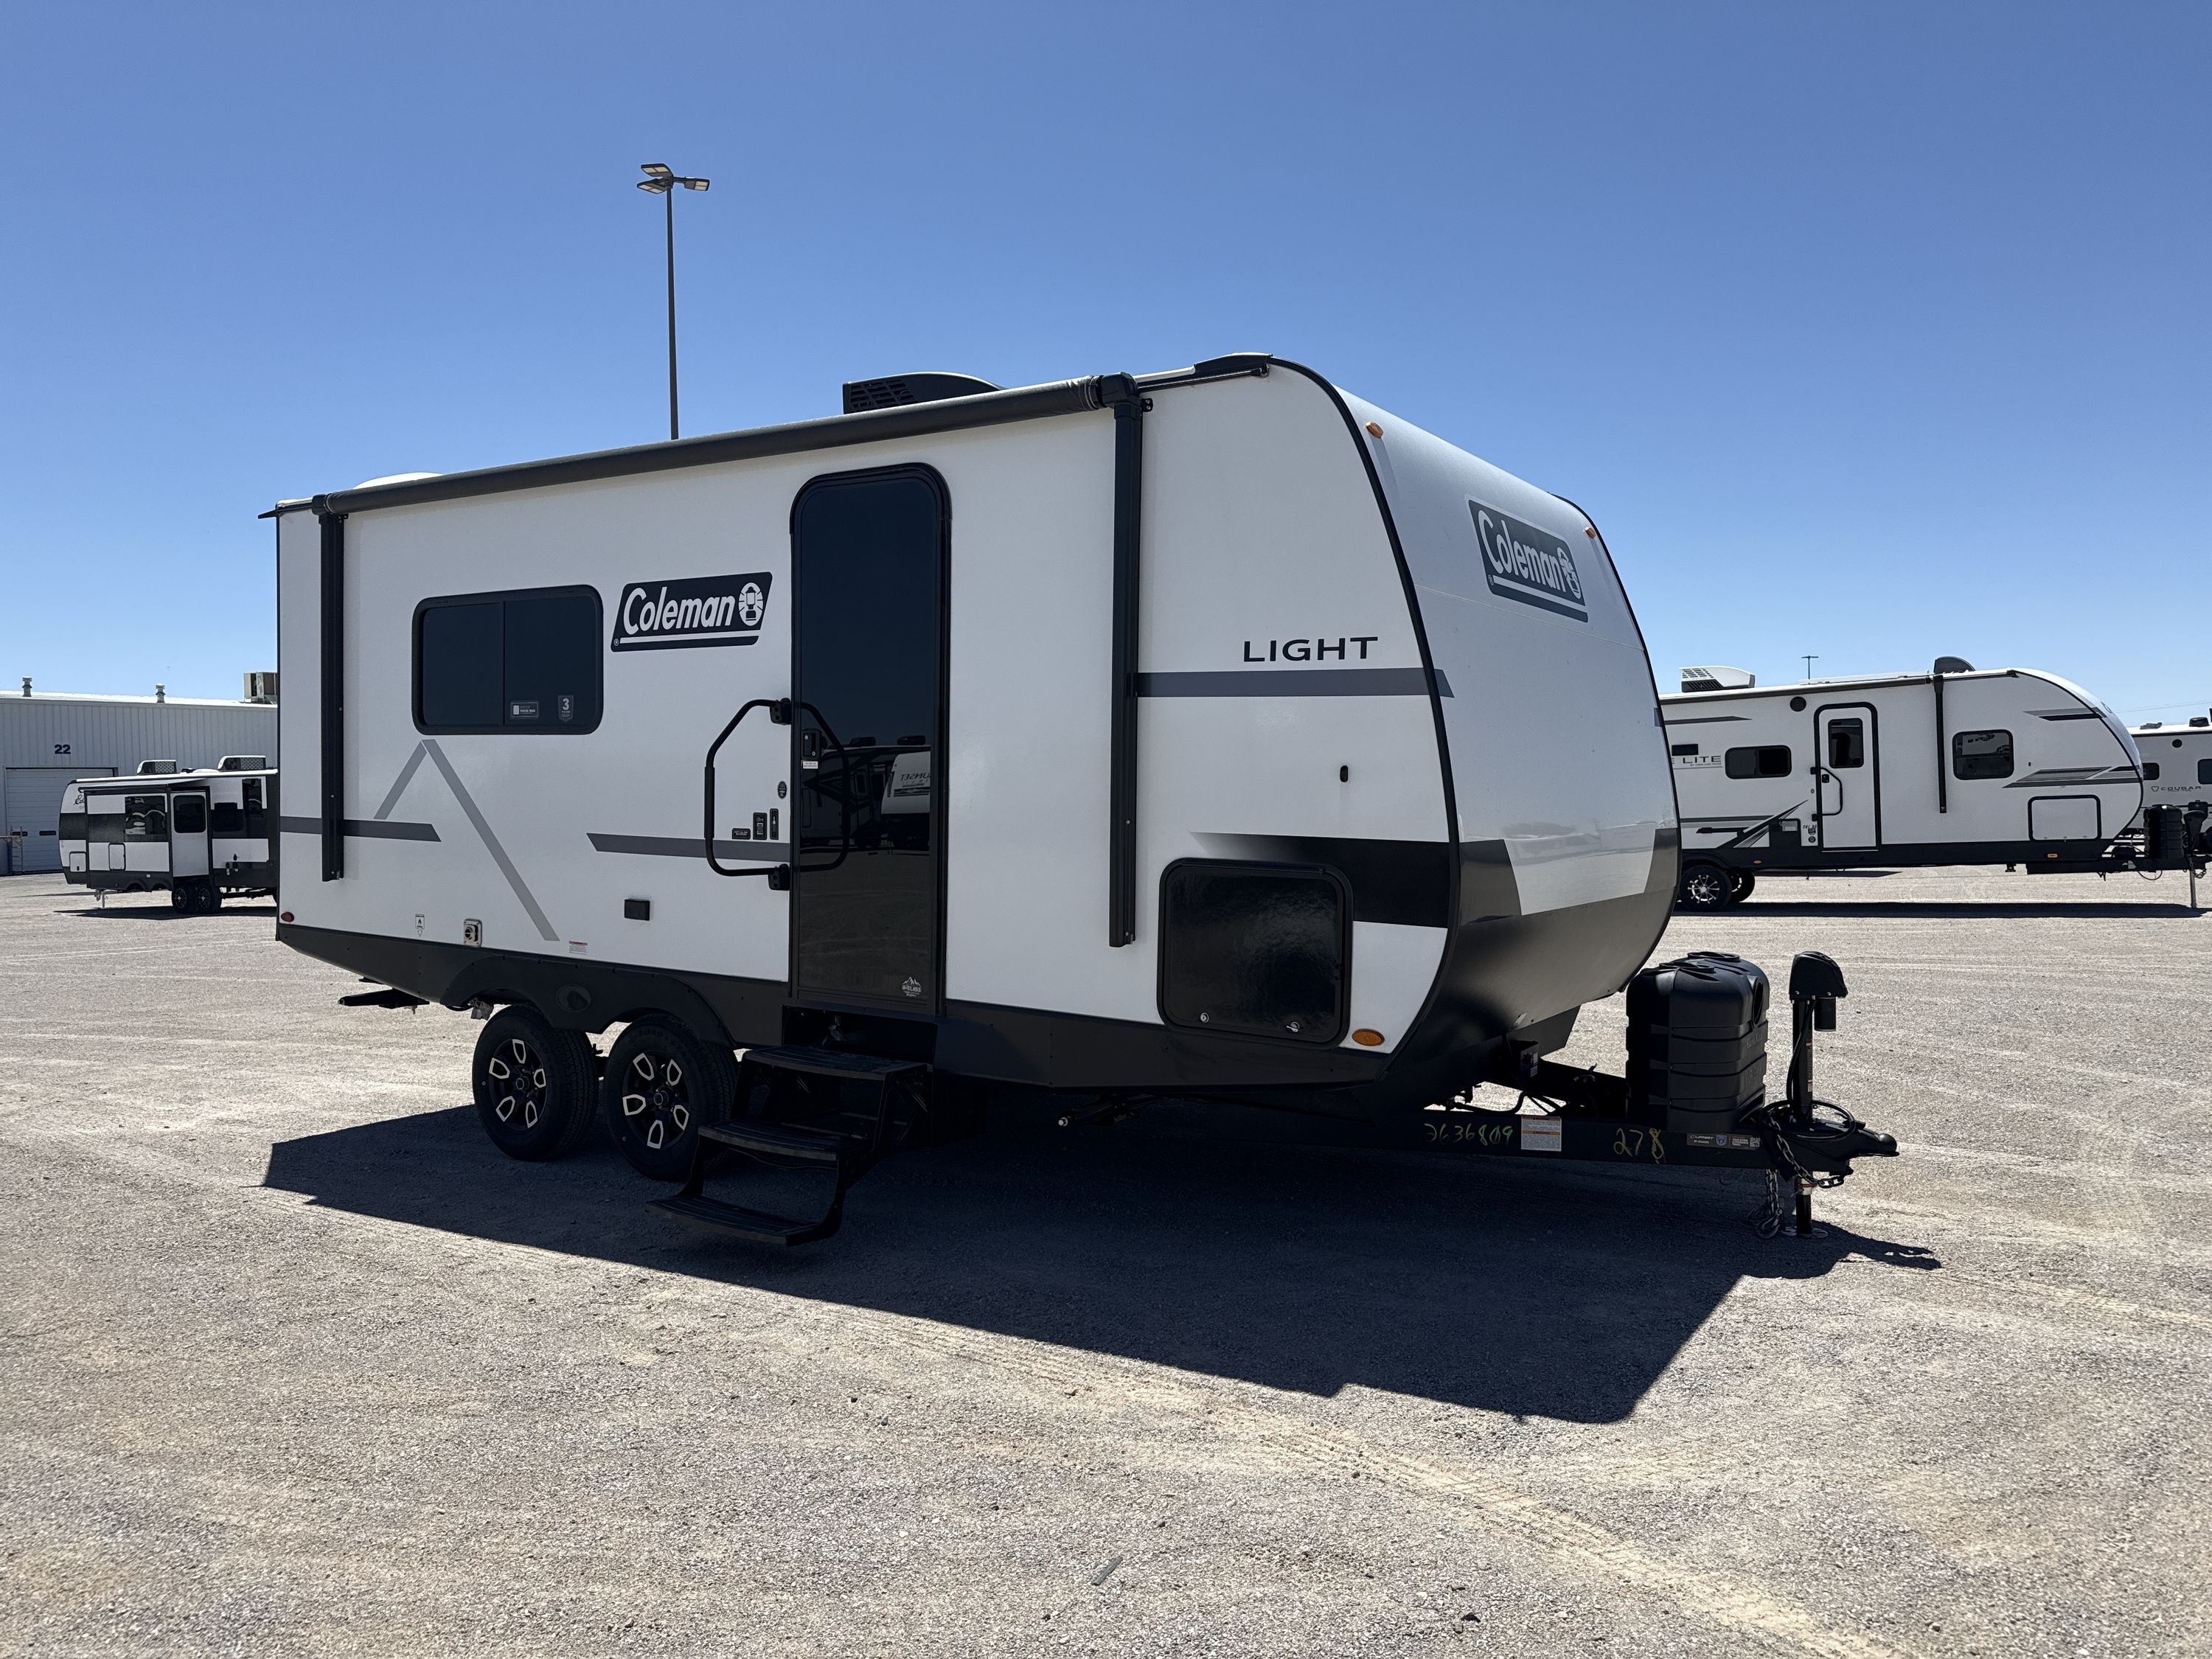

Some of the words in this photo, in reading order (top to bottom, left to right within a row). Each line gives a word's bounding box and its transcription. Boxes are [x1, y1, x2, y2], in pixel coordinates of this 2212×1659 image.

[1478, 509, 1567, 593] Coleman
[623, 586, 736, 636] Coleman
[1243, 636, 1379, 662] LIGHT
[562, 698, 570, 710] 3
[54, 744, 72, 754] 22
[1683, 755, 1722, 764] LITE
[1613, 1127, 1665, 1164] 278
